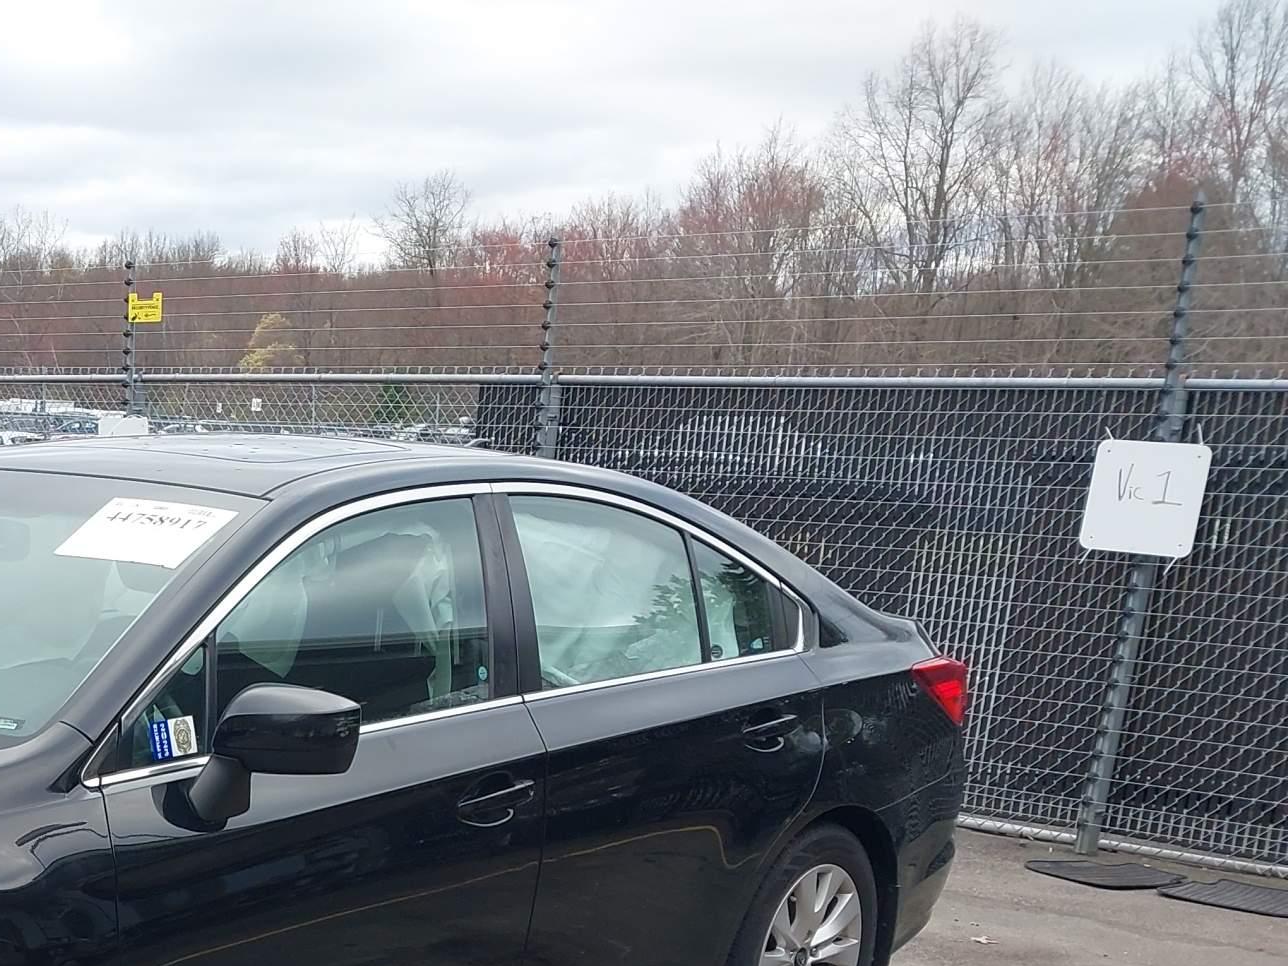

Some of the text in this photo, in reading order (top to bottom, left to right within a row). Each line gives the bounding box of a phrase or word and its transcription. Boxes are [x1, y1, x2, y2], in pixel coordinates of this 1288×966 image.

[1117, 463, 1183, 506] Vic 1
[106, 511, 208, 529] 44758917
